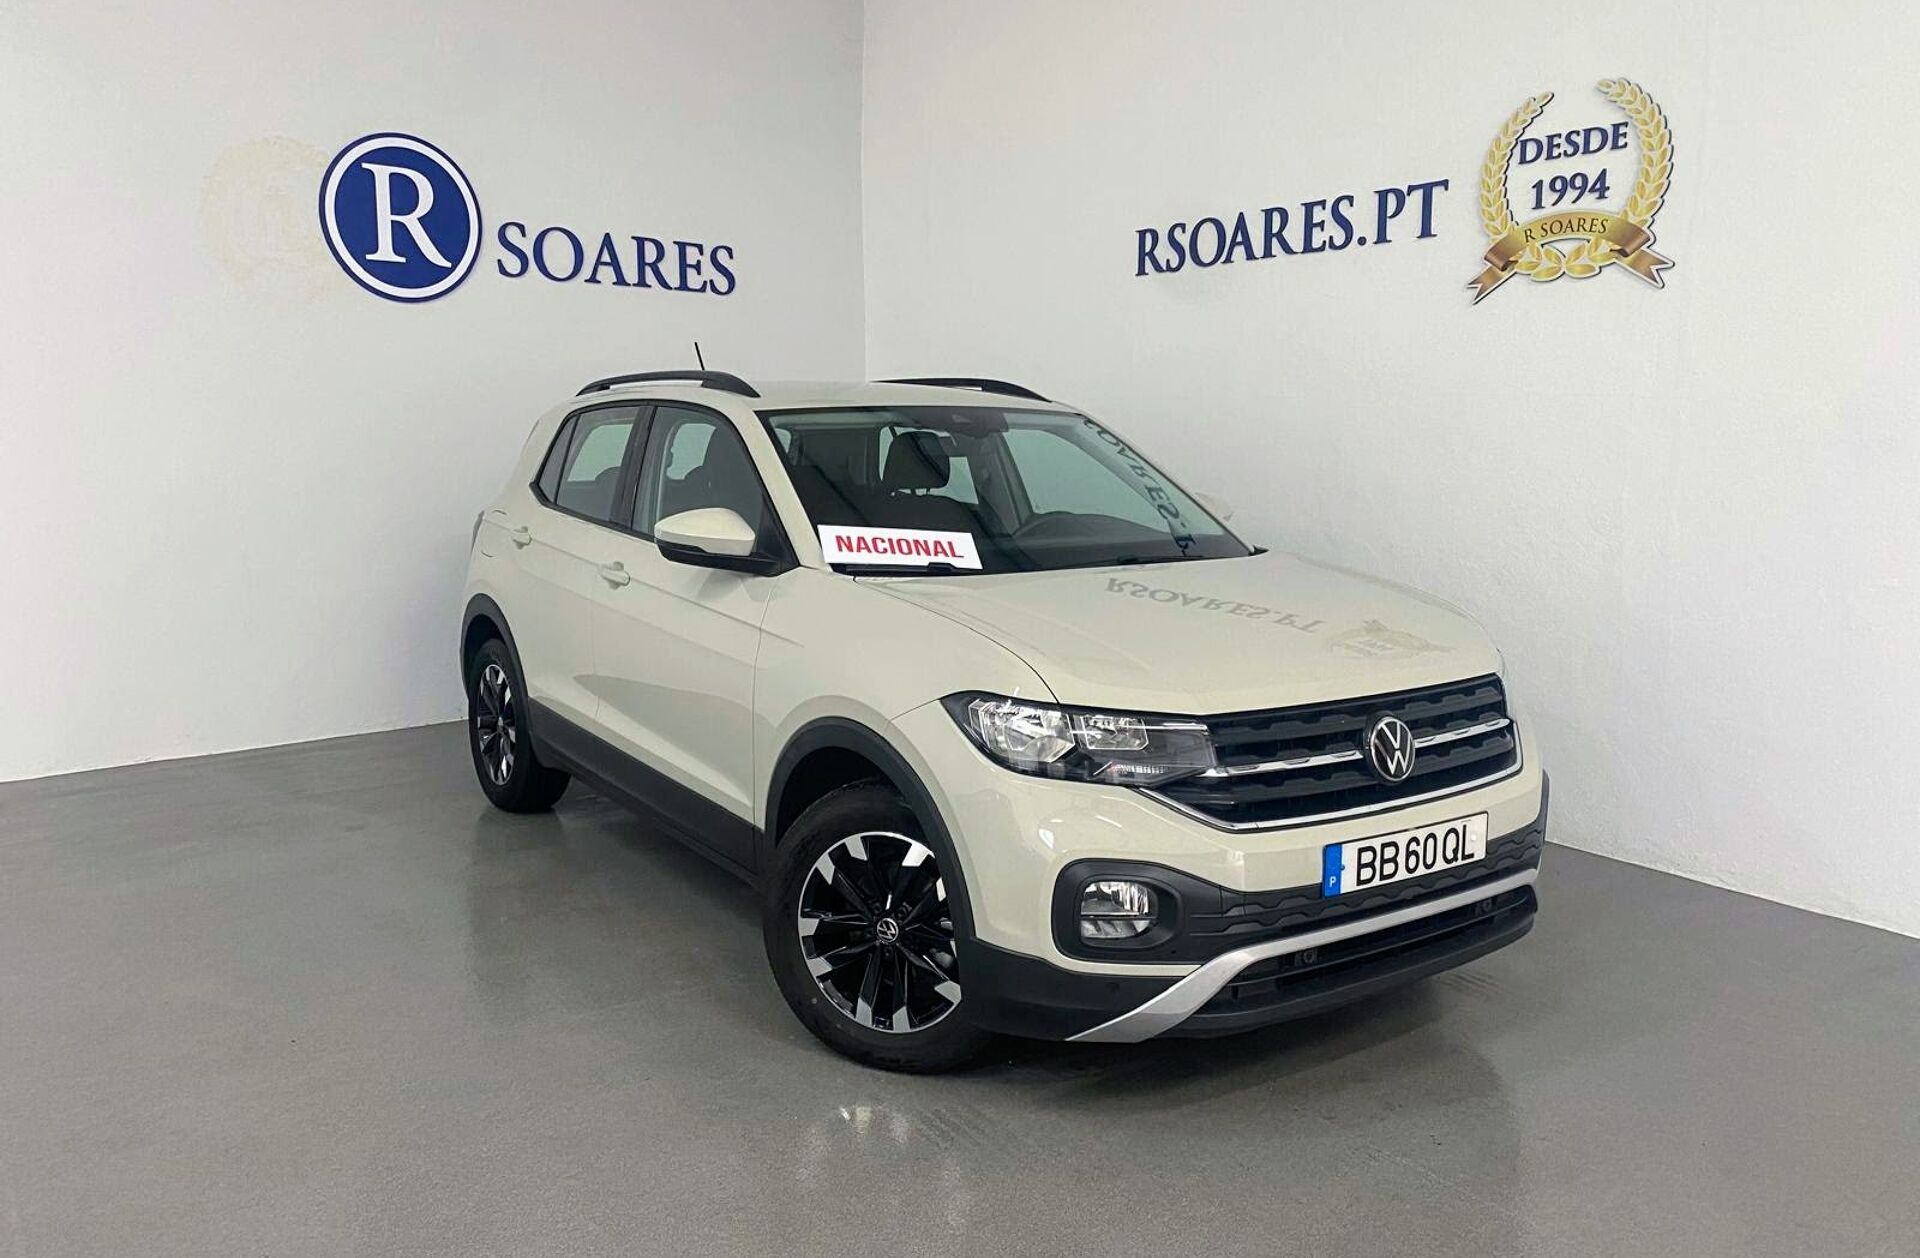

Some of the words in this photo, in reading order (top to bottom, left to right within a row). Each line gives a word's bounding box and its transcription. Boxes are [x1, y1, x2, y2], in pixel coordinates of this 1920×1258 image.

[1518, 121, 1629, 165] DESDE
[1531, 168, 1610, 210] 1994
[361, 162, 452, 268] R
[496, 222, 736, 296] SOARES
[1135, 179, 1449, 277] RSOARES.PT
[1524, 228, 1536, 243] R
[1540, 217, 1609, 238] SOARES
[835, 535, 964, 559] NACIONAL
[1329, 876, 1336, 887] P
[1356, 841, 1400, 886] BB
[1405, 832, 1437, 874] 60
[1442, 824, 1475, 864] QL
